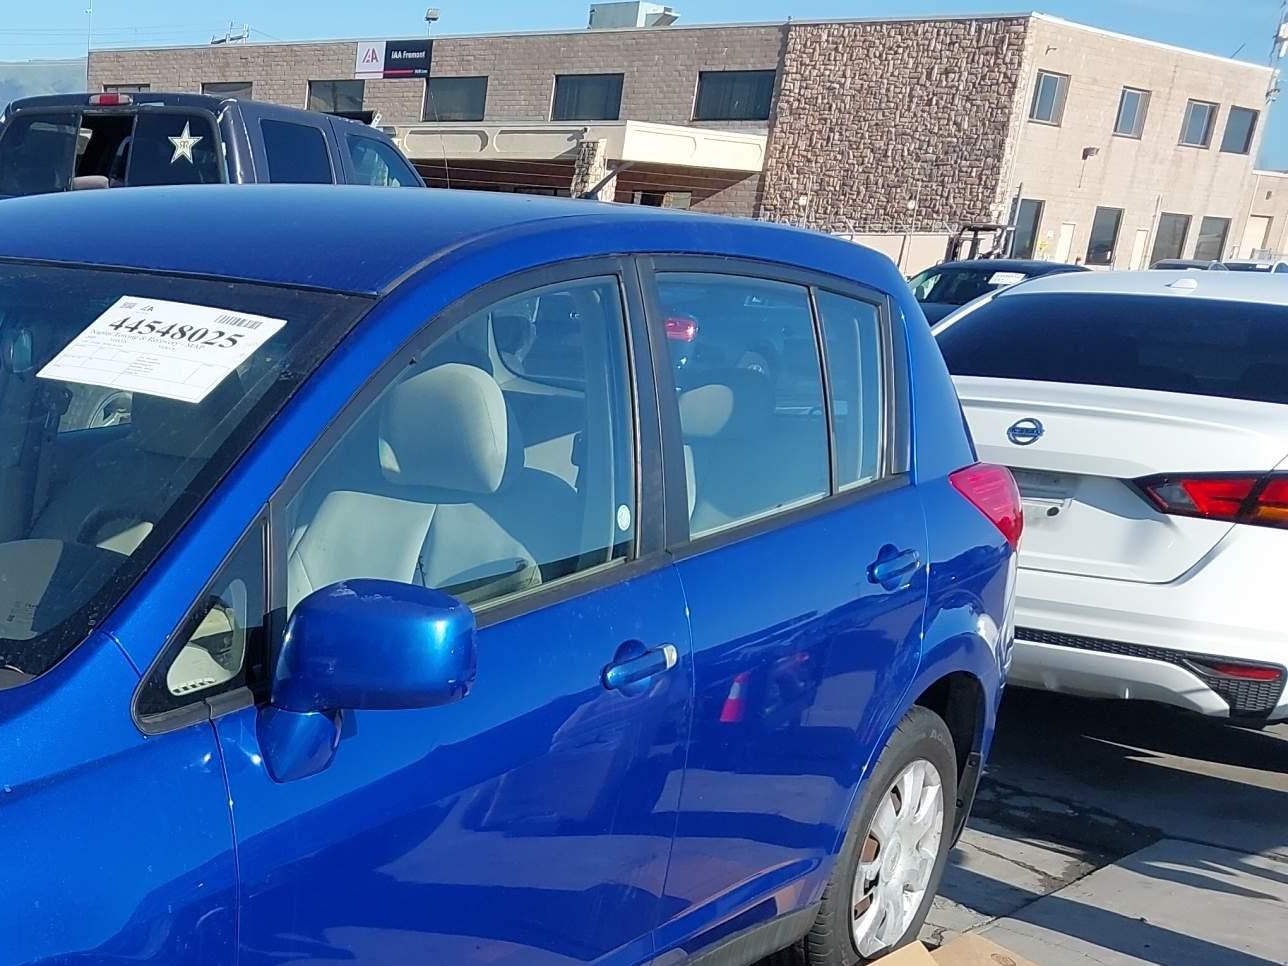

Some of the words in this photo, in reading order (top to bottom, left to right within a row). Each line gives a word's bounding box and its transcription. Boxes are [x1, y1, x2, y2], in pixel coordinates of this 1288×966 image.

[391, 50, 402, 59] IAA
[403, 49, 426, 60] Fremont
[109, 316, 245, 348] 44548025
